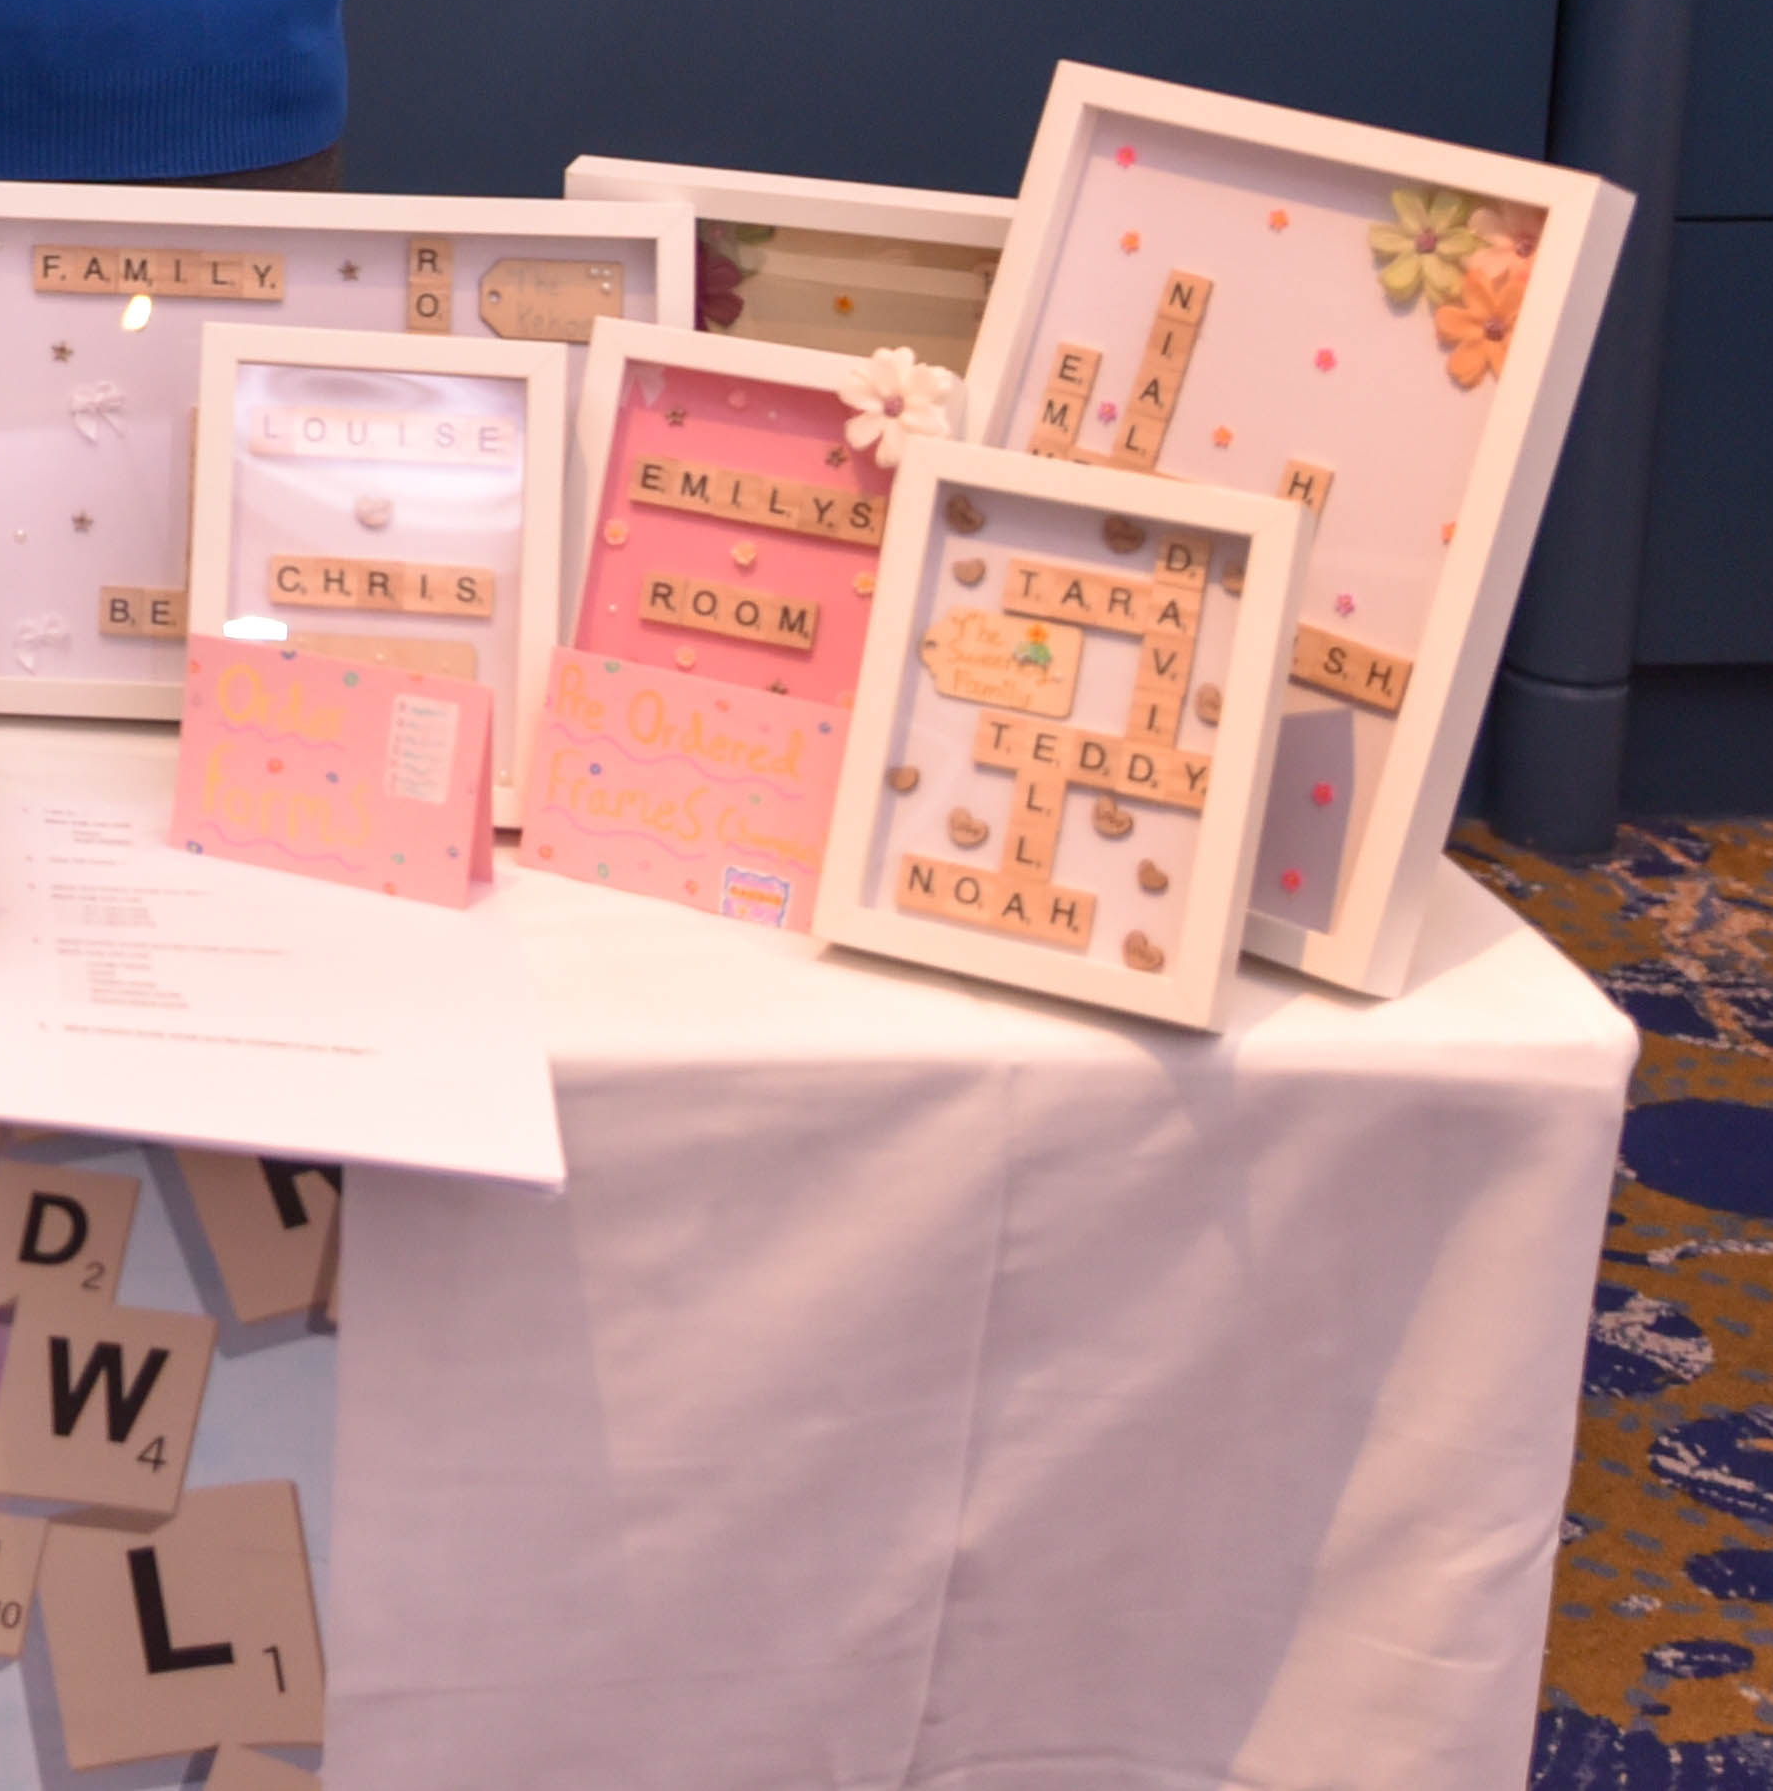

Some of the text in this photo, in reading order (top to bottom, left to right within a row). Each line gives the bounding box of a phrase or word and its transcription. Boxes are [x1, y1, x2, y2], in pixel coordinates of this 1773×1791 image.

[40, 253, 278, 291] FAMILY
[261, 414, 505, 455] LOUISE
[640, 463, 877, 534] EMILYS
[275, 564, 484, 604] CHRIS
[649, 581, 811, 641] ROOM
[1018, 569, 1189, 631] TARA
[627, 688, 807, 783] Ordered
[990, 721, 1209, 796] TEDDY
[907, 864, 1081, 935] NOAH
